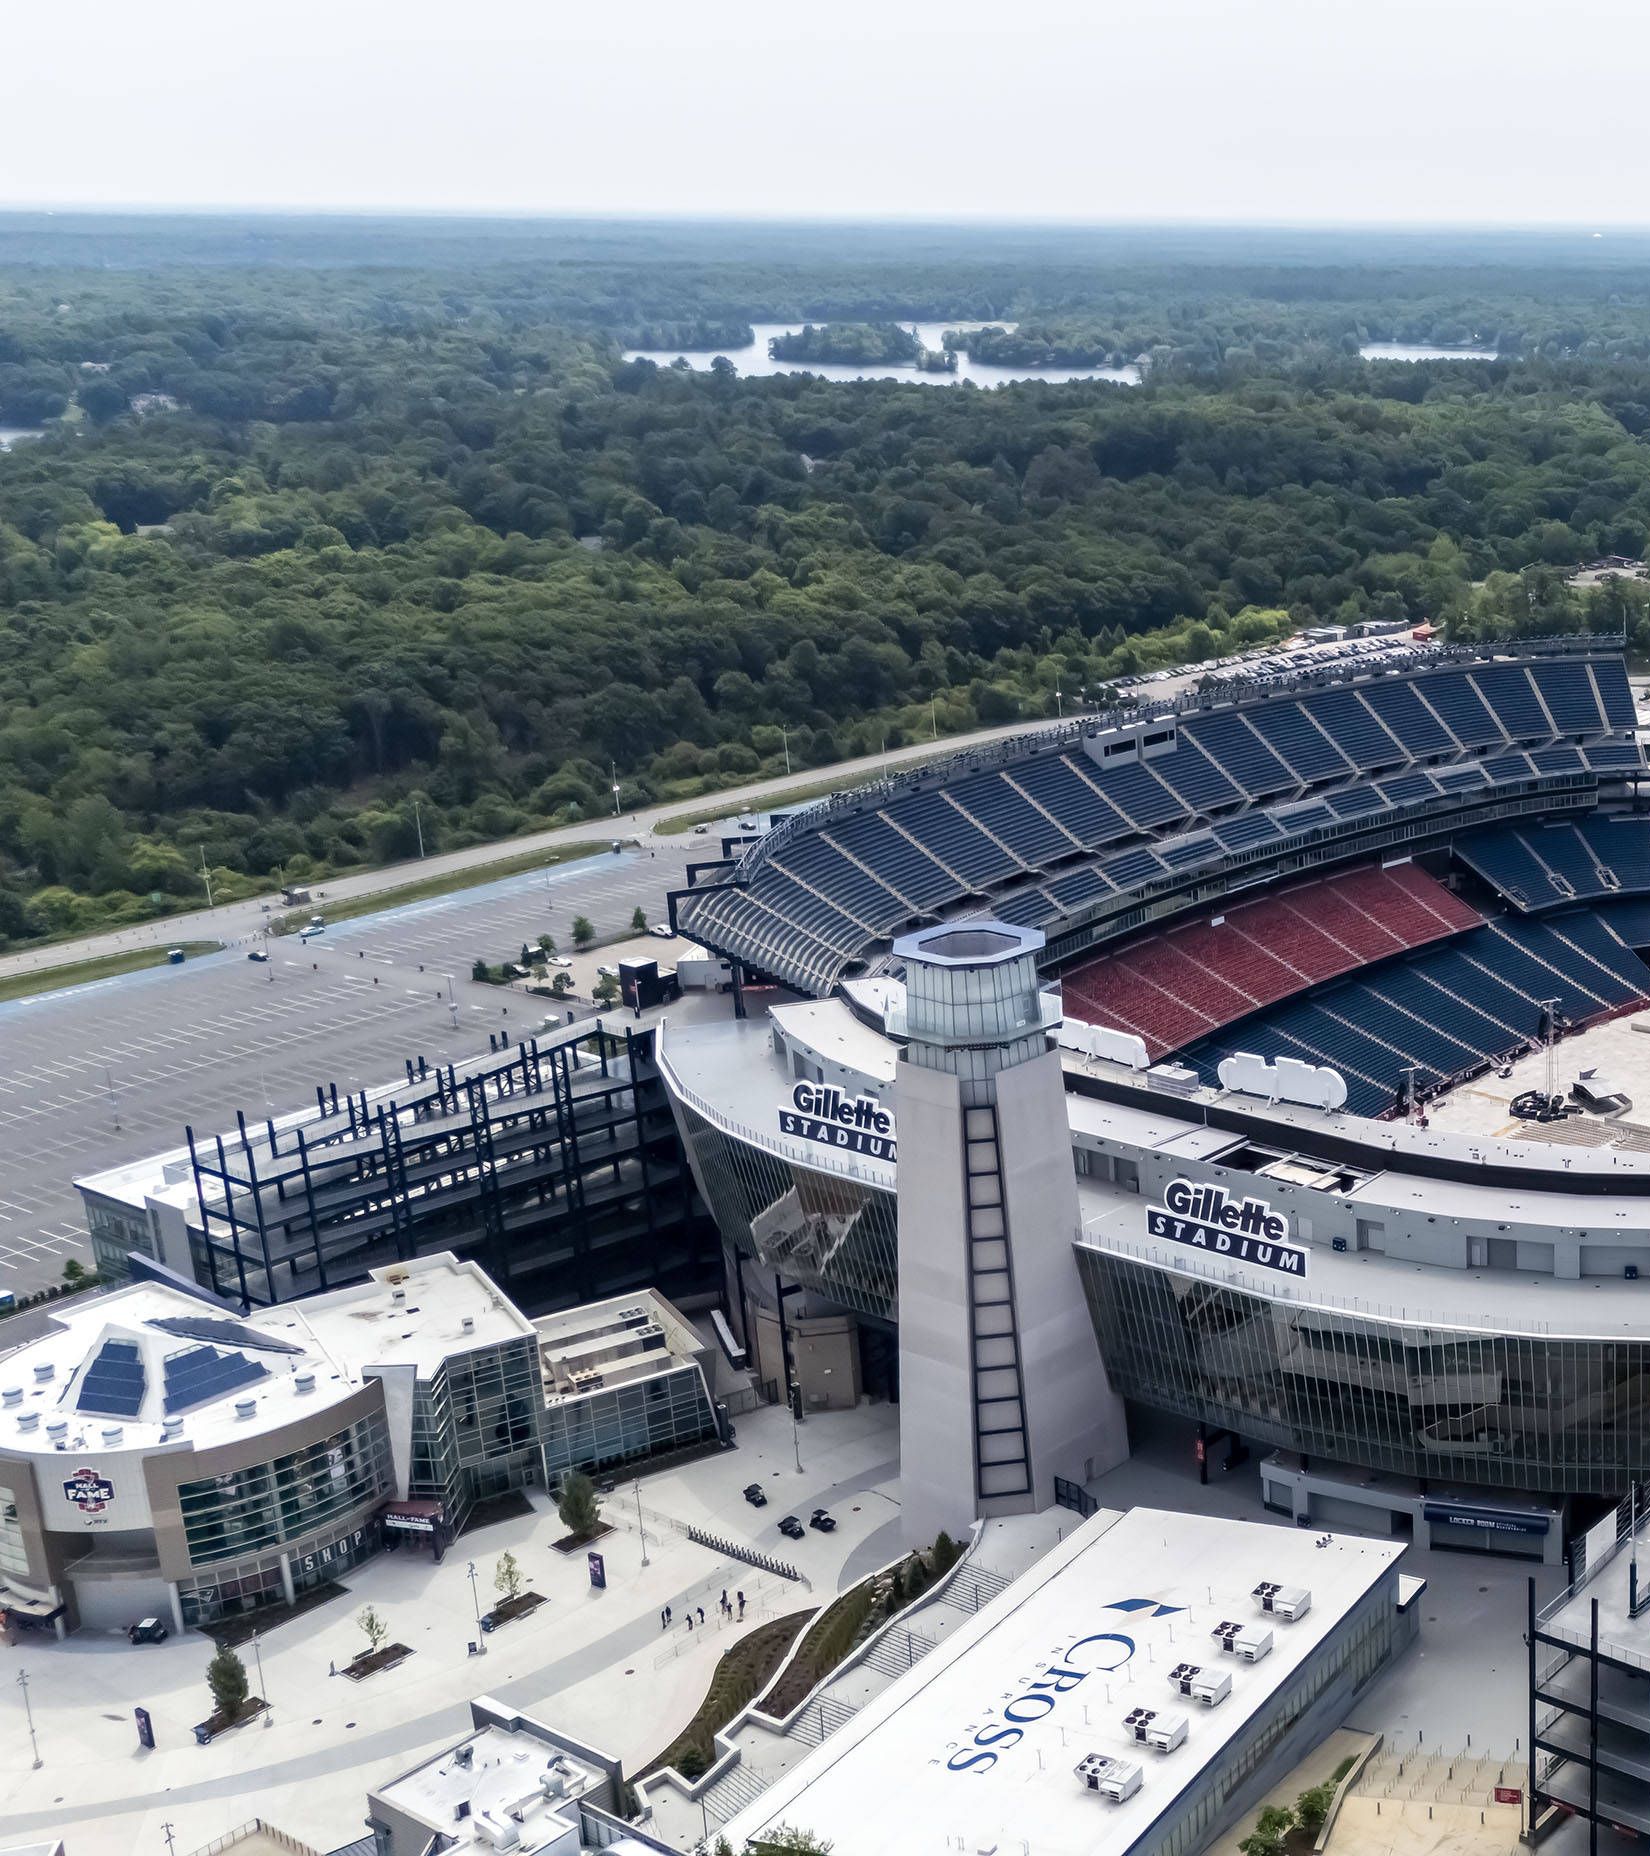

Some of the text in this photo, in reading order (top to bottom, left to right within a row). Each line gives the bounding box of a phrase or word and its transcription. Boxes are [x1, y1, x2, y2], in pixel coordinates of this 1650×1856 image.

[793, 1084, 891, 1135] Gillette
[1166, 1182, 1284, 1241] Gillette
[1154, 1216, 1299, 1271] STADIUM
[67, 1488, 111, 1500] FAME
[410, 1516, 430, 1524] FAME
[1449, 1516, 1475, 1526] LOCKER
[1477, 1519, 1496, 1528] ROOM
[304, 1530, 361, 1571] SHOP
[928, 1634, 1077, 1766] INSURANCE
[947, 1633, 1136, 1775] CROSS
